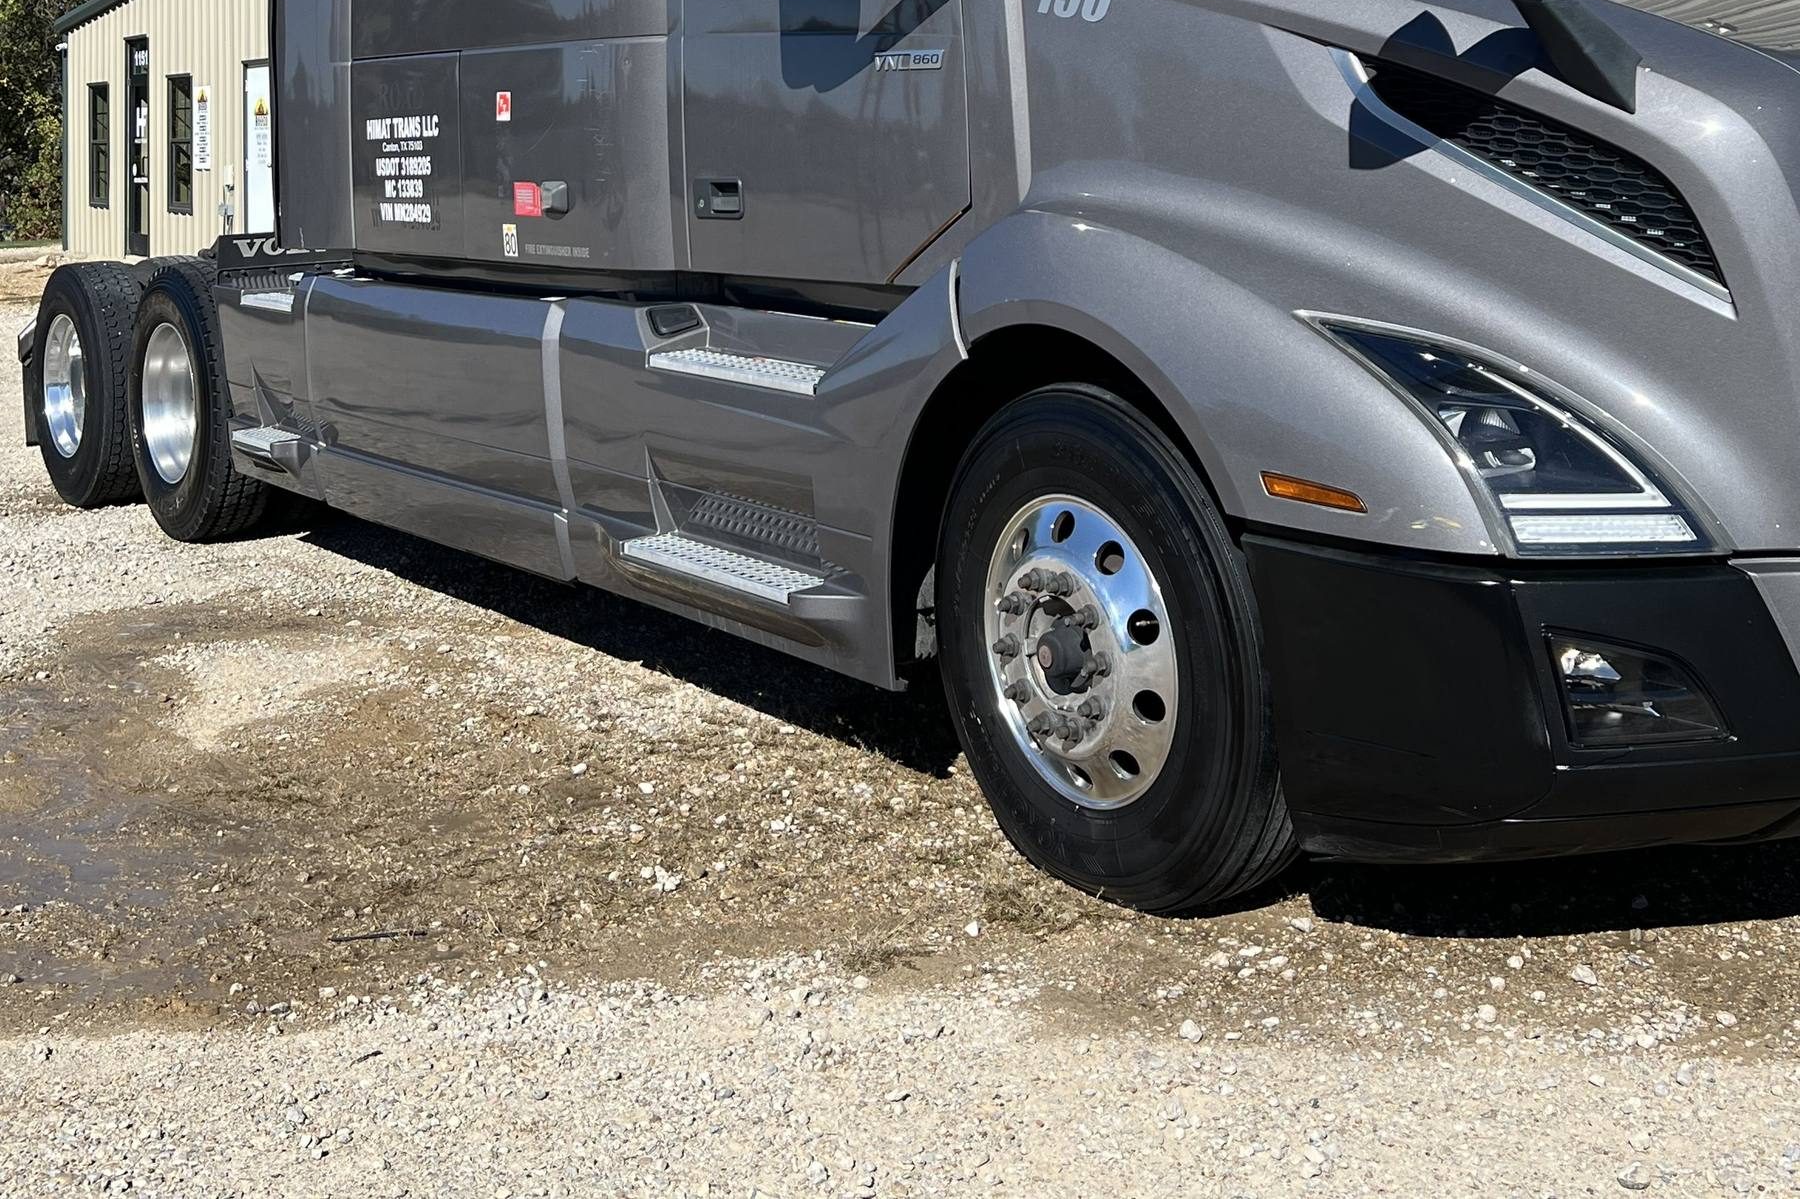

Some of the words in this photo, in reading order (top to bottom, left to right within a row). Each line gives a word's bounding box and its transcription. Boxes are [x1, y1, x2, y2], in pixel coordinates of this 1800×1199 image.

[874, 53, 910, 71] VNL
[912, 53, 939, 65] 860
[366, 118, 391, 140] HIMAT
[392, 116, 421, 139] TRANS
[422, 115, 439, 137] LLC
[400, 141, 407, 151] TX
[376, 157, 399, 176] USDOT
[385, 179, 396, 198] MC
[379, 202, 393, 221] VIN
[504, 233, 517, 255] 80
[525, 243, 536, 255] FIRE
[536, 244, 572, 257] EXTINGUISHER
[572, 246, 590, 258] INSIDE
